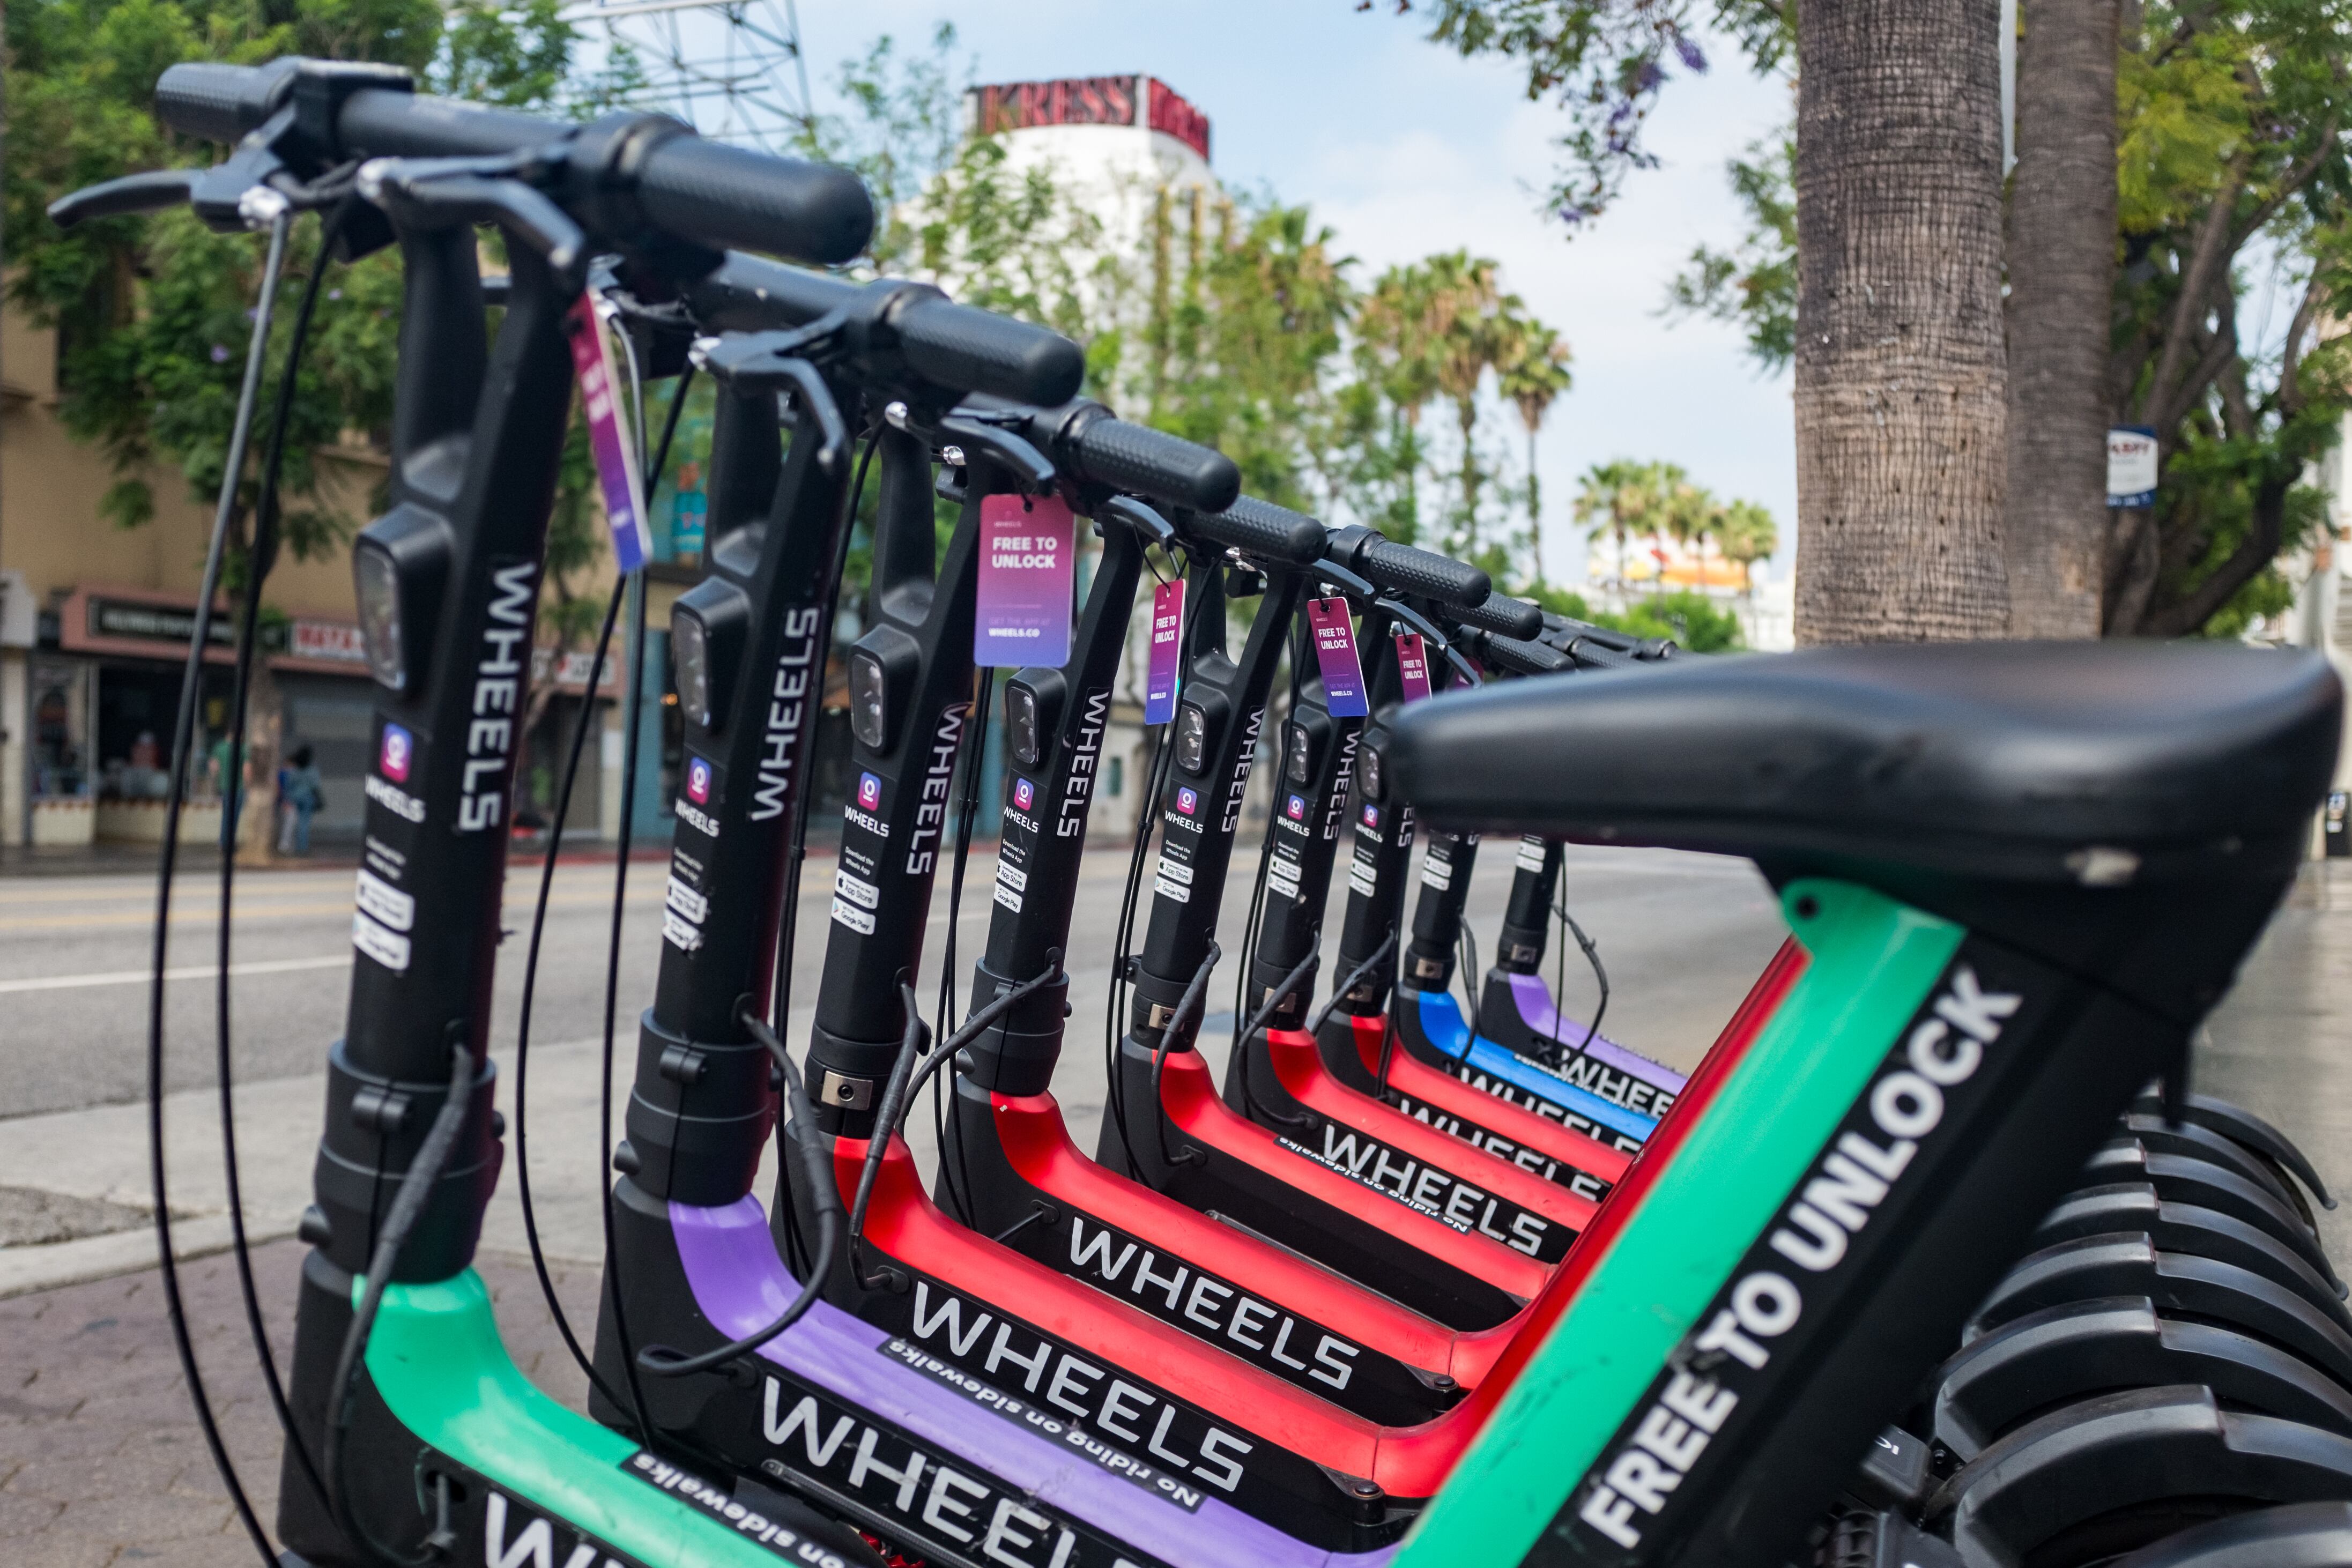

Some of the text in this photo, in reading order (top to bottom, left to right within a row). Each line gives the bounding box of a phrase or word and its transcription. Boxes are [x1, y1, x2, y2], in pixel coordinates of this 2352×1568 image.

[982, 75, 1132, 134] KRESS
[992, 537, 1057, 551] FREE TO
[992, 554, 1056, 569] UNLOCK
[1156, 615, 1176, 629] FREE TO
[1318, 627, 1346, 638] FREE TO
[1155, 630, 1175, 643] UNLOCK
[1320, 639, 1348, 650] UNLOCK
[1403, 659, 1421, 668] FREE TO
[1405, 670, 1423, 679] UNLOCK
[459, 562, 536, 831] WHEELS
[752, 607, 820, 820] WHEELS
[1057, 692, 1109, 837] WHEELS
[1221, 708, 1265, 832] WHEELS
[906, 703, 972, 874] WHEELS
[1324, 731, 1361, 839] WHEELS
[675, 797, 719, 837] WHEELS
[844, 805, 889, 837] WHEELS
[1004, 806, 1039, 833] WHEELS
[1165, 810, 1204, 834] WHEELS
[1277, 815, 1310, 837] WHEELS
[1355, 822, 1383, 843] WHEELS
[1003, 838, 1019, 852] Download
[1003, 848, 1014, 859] Wheels
[1166, 839, 1184, 851] Download
[1179, 852, 1188, 860] App
[1001, 870, 1022, 887] App Store
[1166, 867, 1189, 880] App Store
[856, 890, 873, 904] Store
[997, 891, 1018, 909] Google Play
[1162, 886, 1186, 900] Google Play
[1279, 1137, 1361, 1178] sidewalks
[1324, 1124, 1547, 1256] WHEELS
[1363, 1177, 1385, 1190] on
[1443, 1216, 1467, 1233] No
[1579, 965, 2023, 1550] FREE TO UNLOCK
[1071, 1216, 1360, 1391] WHEELS
[912, 1280, 1255, 1492] WHEELS
[889, 1340, 1200, 1508] No riding on sidewalks
[762, 1376, 1147, 1568] WHEEL
[634, 1453, 797, 1548] sidewalks
